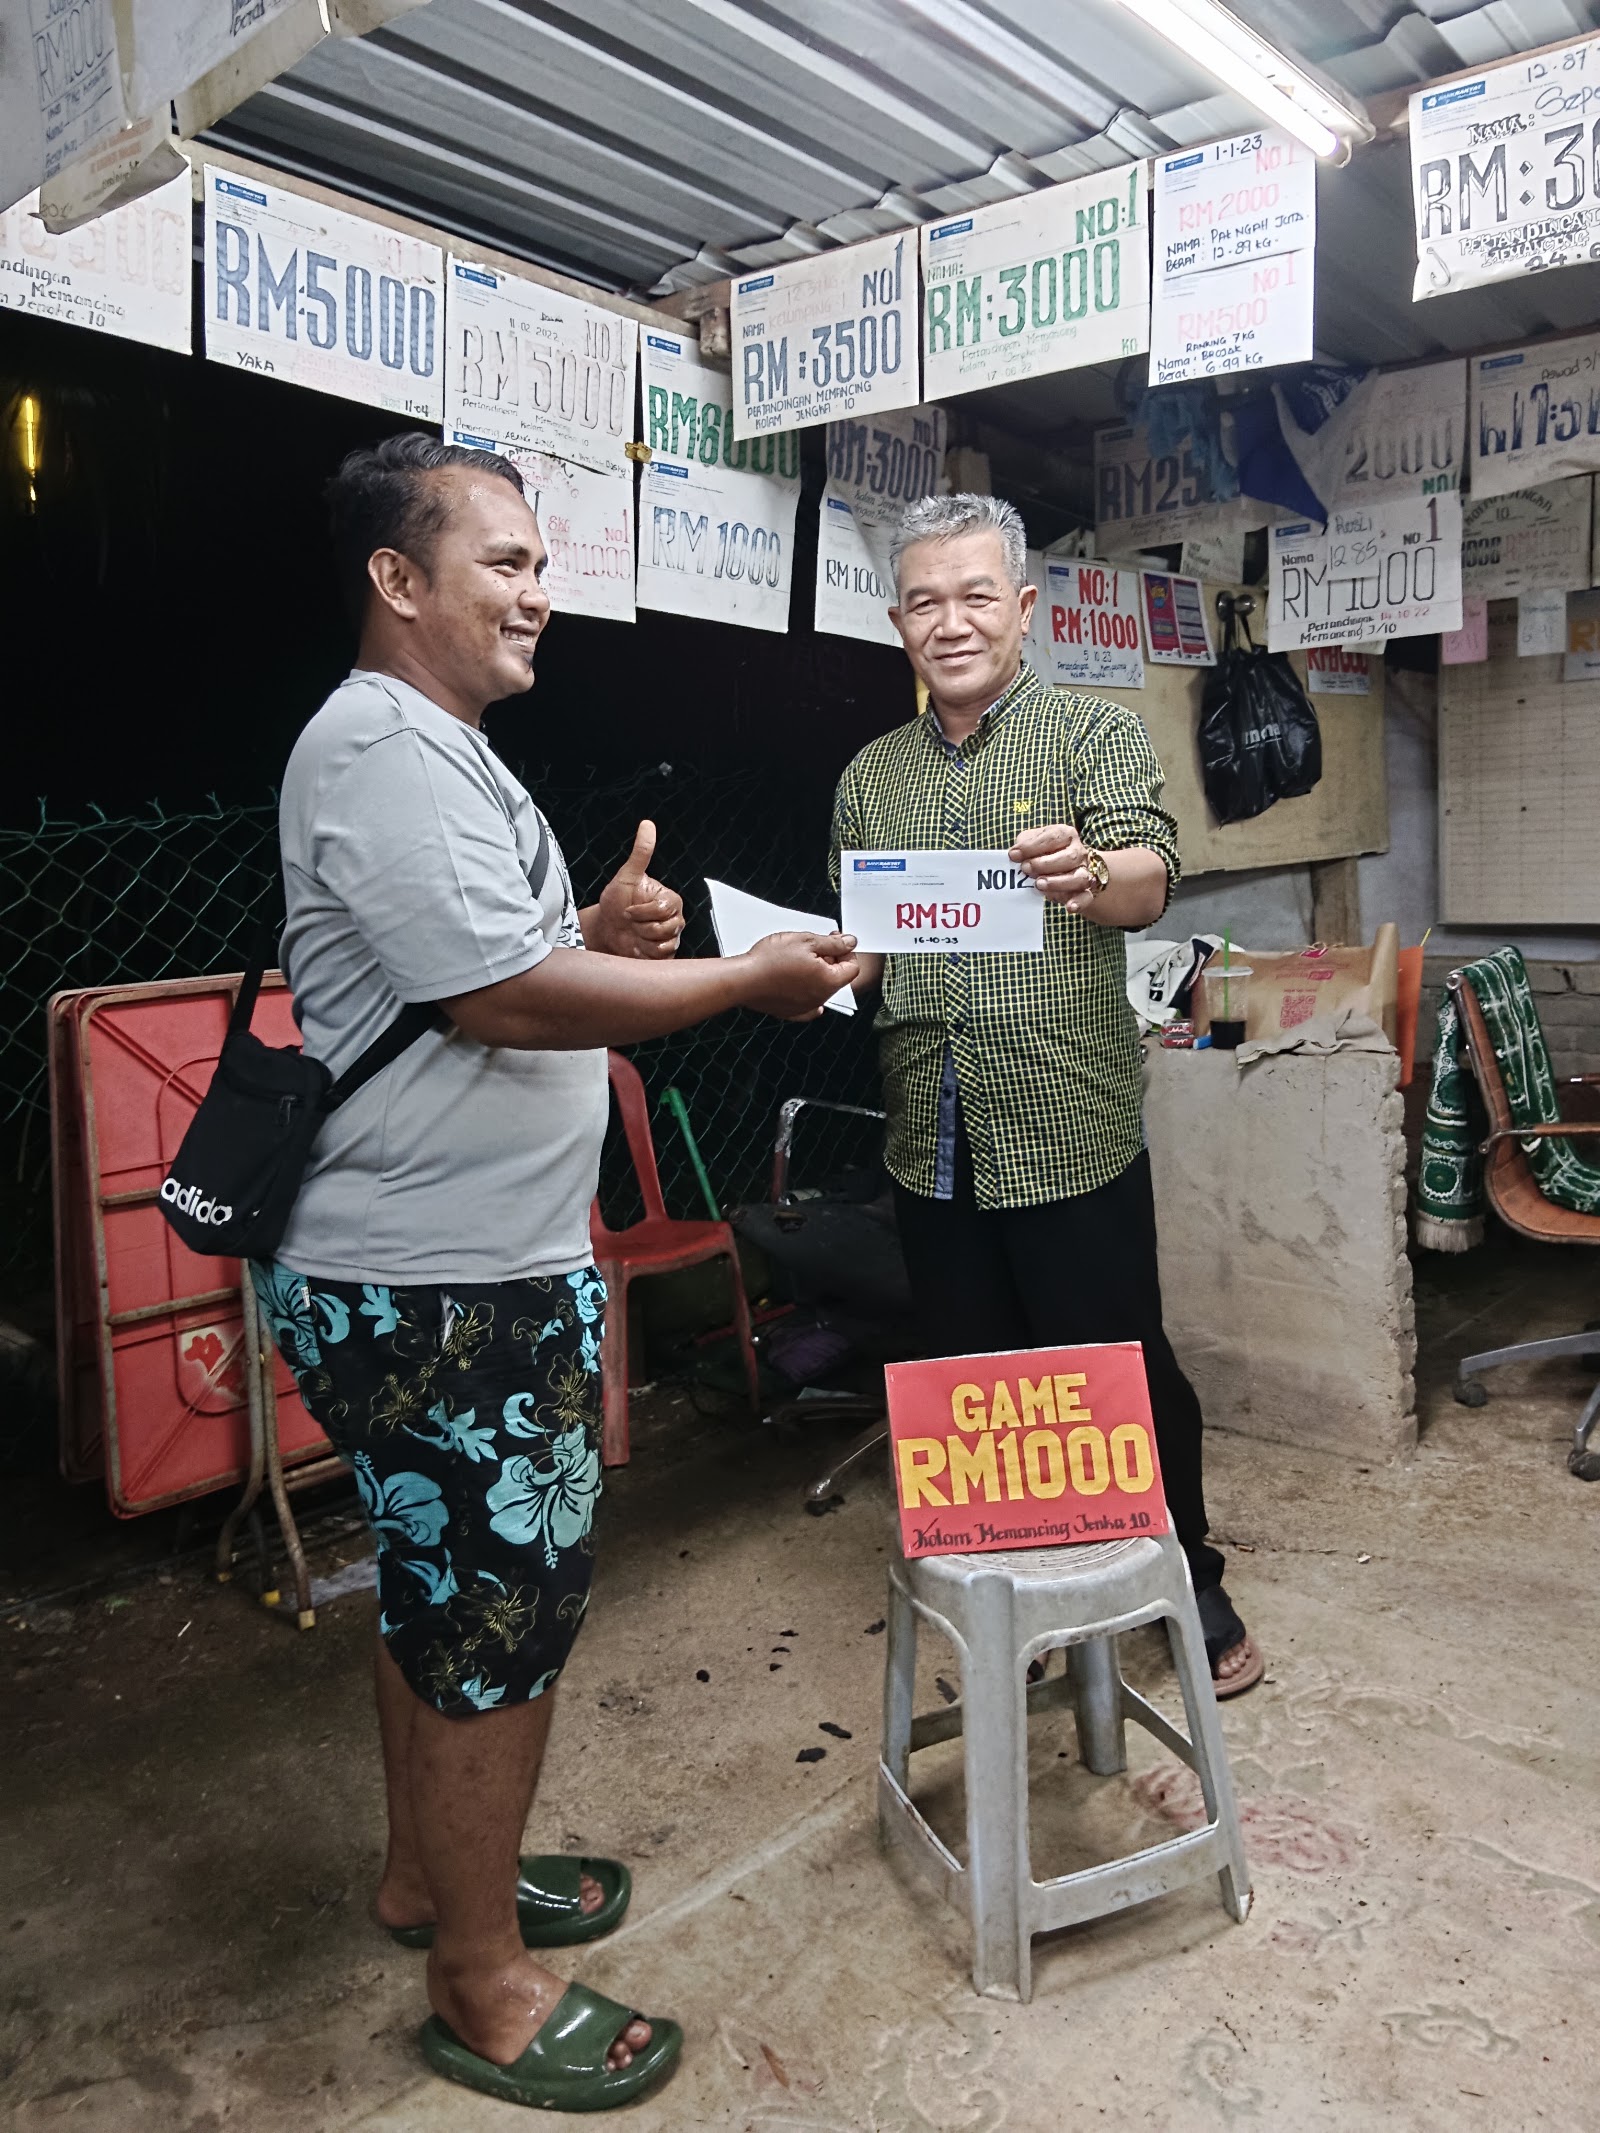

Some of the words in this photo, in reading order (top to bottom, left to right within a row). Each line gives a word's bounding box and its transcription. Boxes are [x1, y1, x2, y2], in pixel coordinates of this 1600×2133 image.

[1051, 604, 1138, 650] RM:1000
[951, 1372, 1092, 1433] GAME
[897, 1423, 1154, 1509] RM1000
